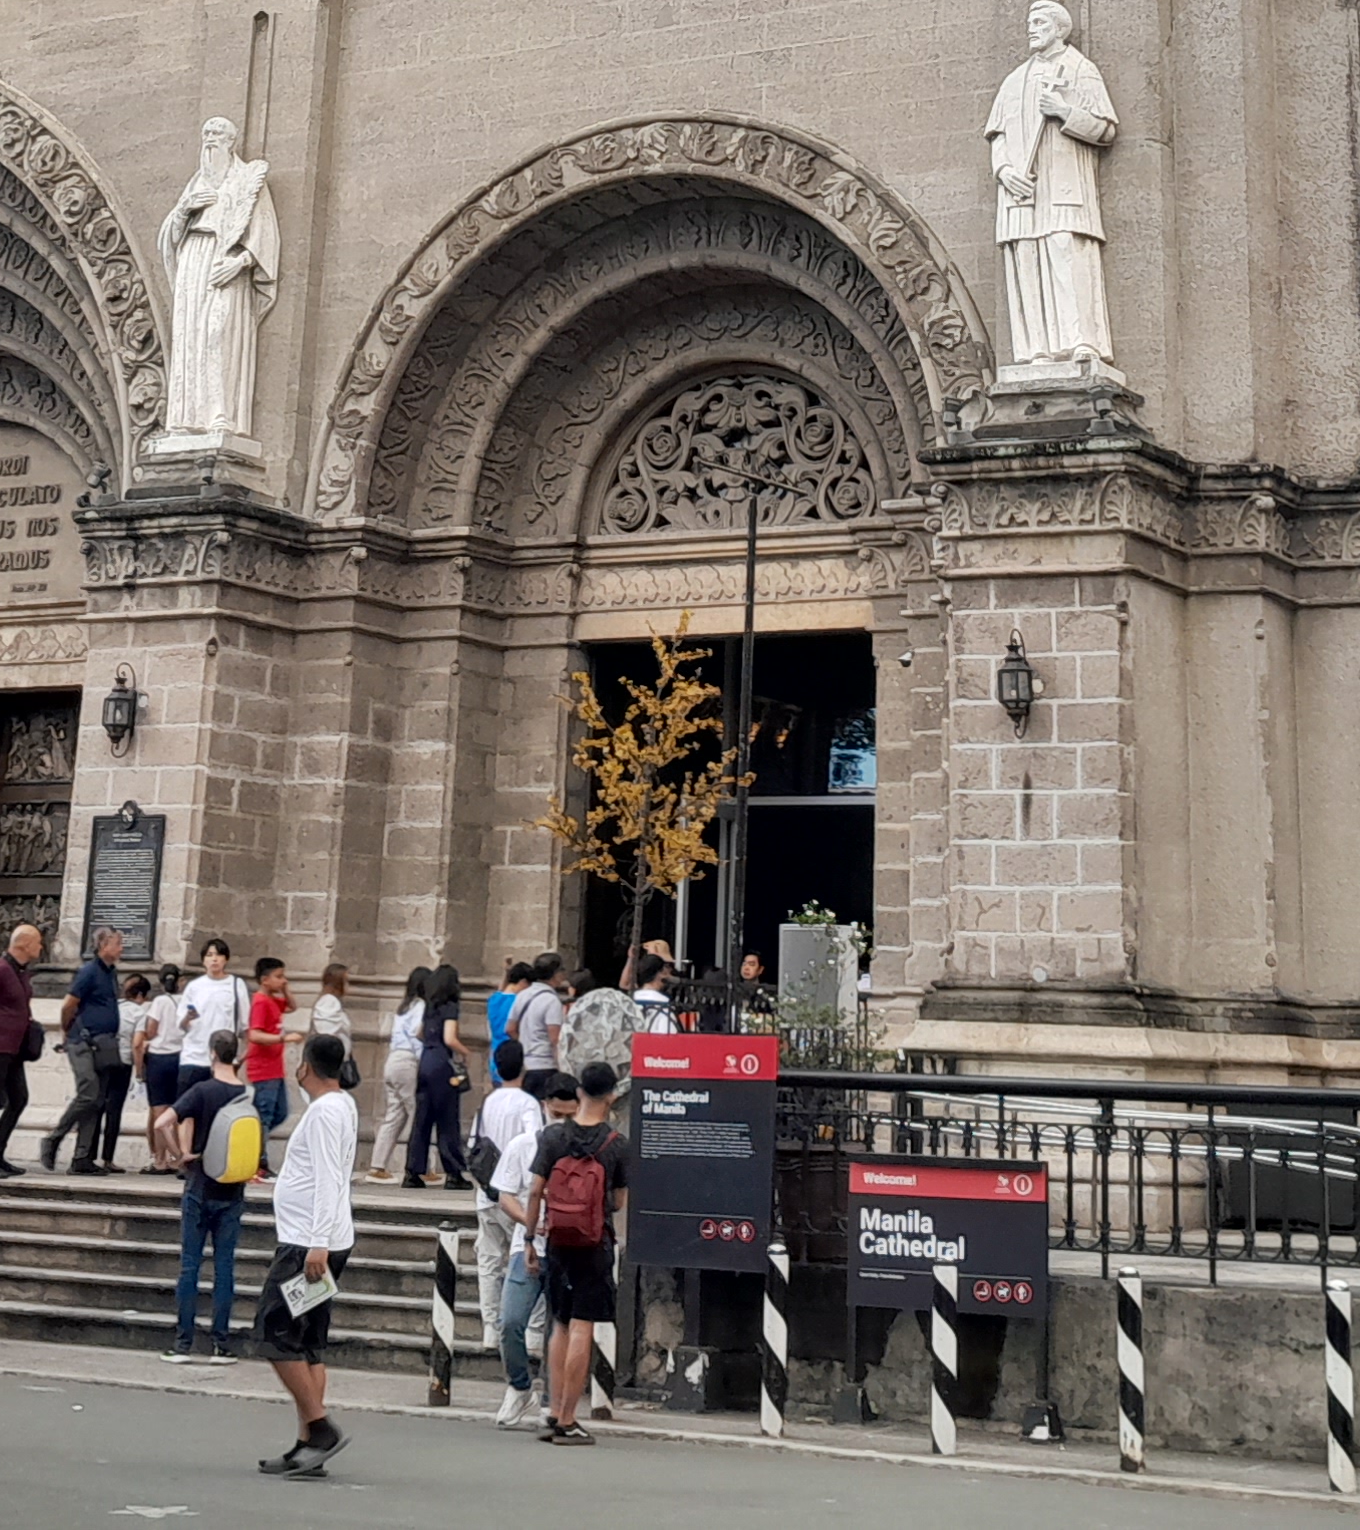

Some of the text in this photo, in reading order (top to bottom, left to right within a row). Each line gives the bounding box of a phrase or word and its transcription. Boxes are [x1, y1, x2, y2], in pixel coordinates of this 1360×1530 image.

[26, 517, 60, 538] NOS
[643, 1056, 690, 1069] Welcome!
[642, 1090, 710, 1103] The Cathedral
[642, 1101, 686, 1115] of Manila
[863, 1172, 917, 1187] Welcome!
[859, 1207, 934, 1234] Manila
[858, 1231, 965, 1261] Cathedral
